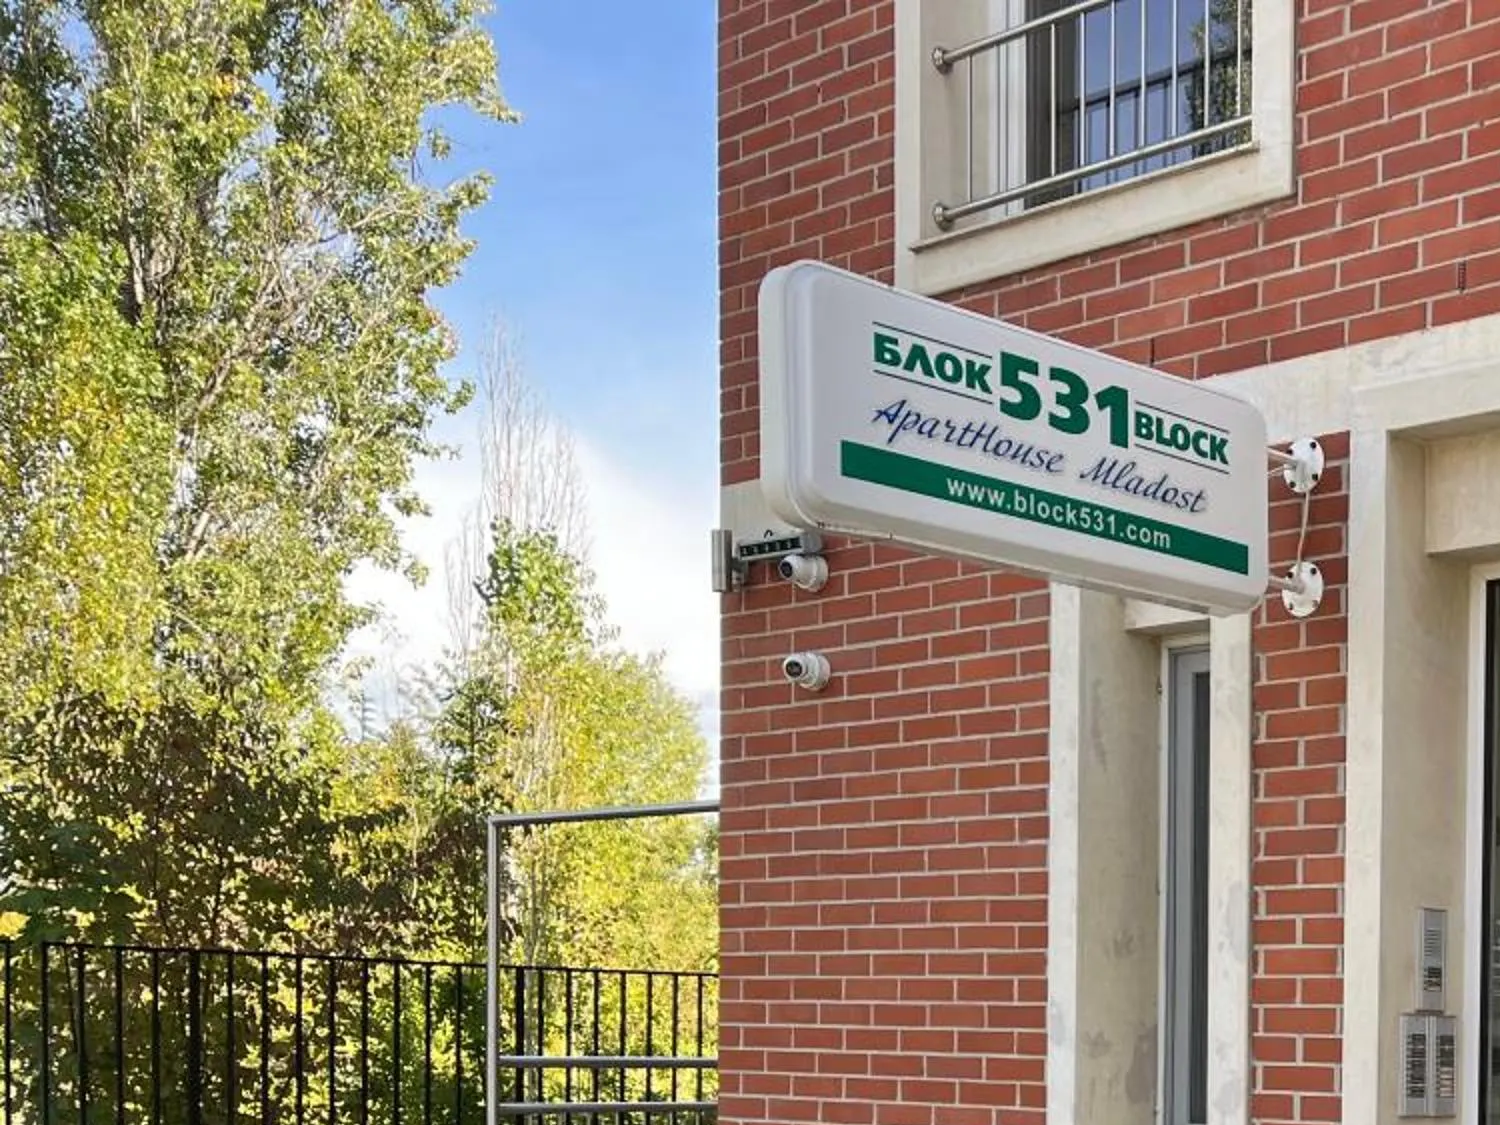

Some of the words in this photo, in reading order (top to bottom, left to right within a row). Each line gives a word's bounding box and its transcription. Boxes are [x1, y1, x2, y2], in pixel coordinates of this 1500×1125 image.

[871, 398, 1065, 475] ApartHouse
[1079, 456, 1208, 514] Mladost
[873, 331, 993, 394] БЛОК
[1000, 351, 1129, 449] 531
[1134, 410, 1230, 465] BLOCK
[946, 477, 1172, 550] www.block531.com
